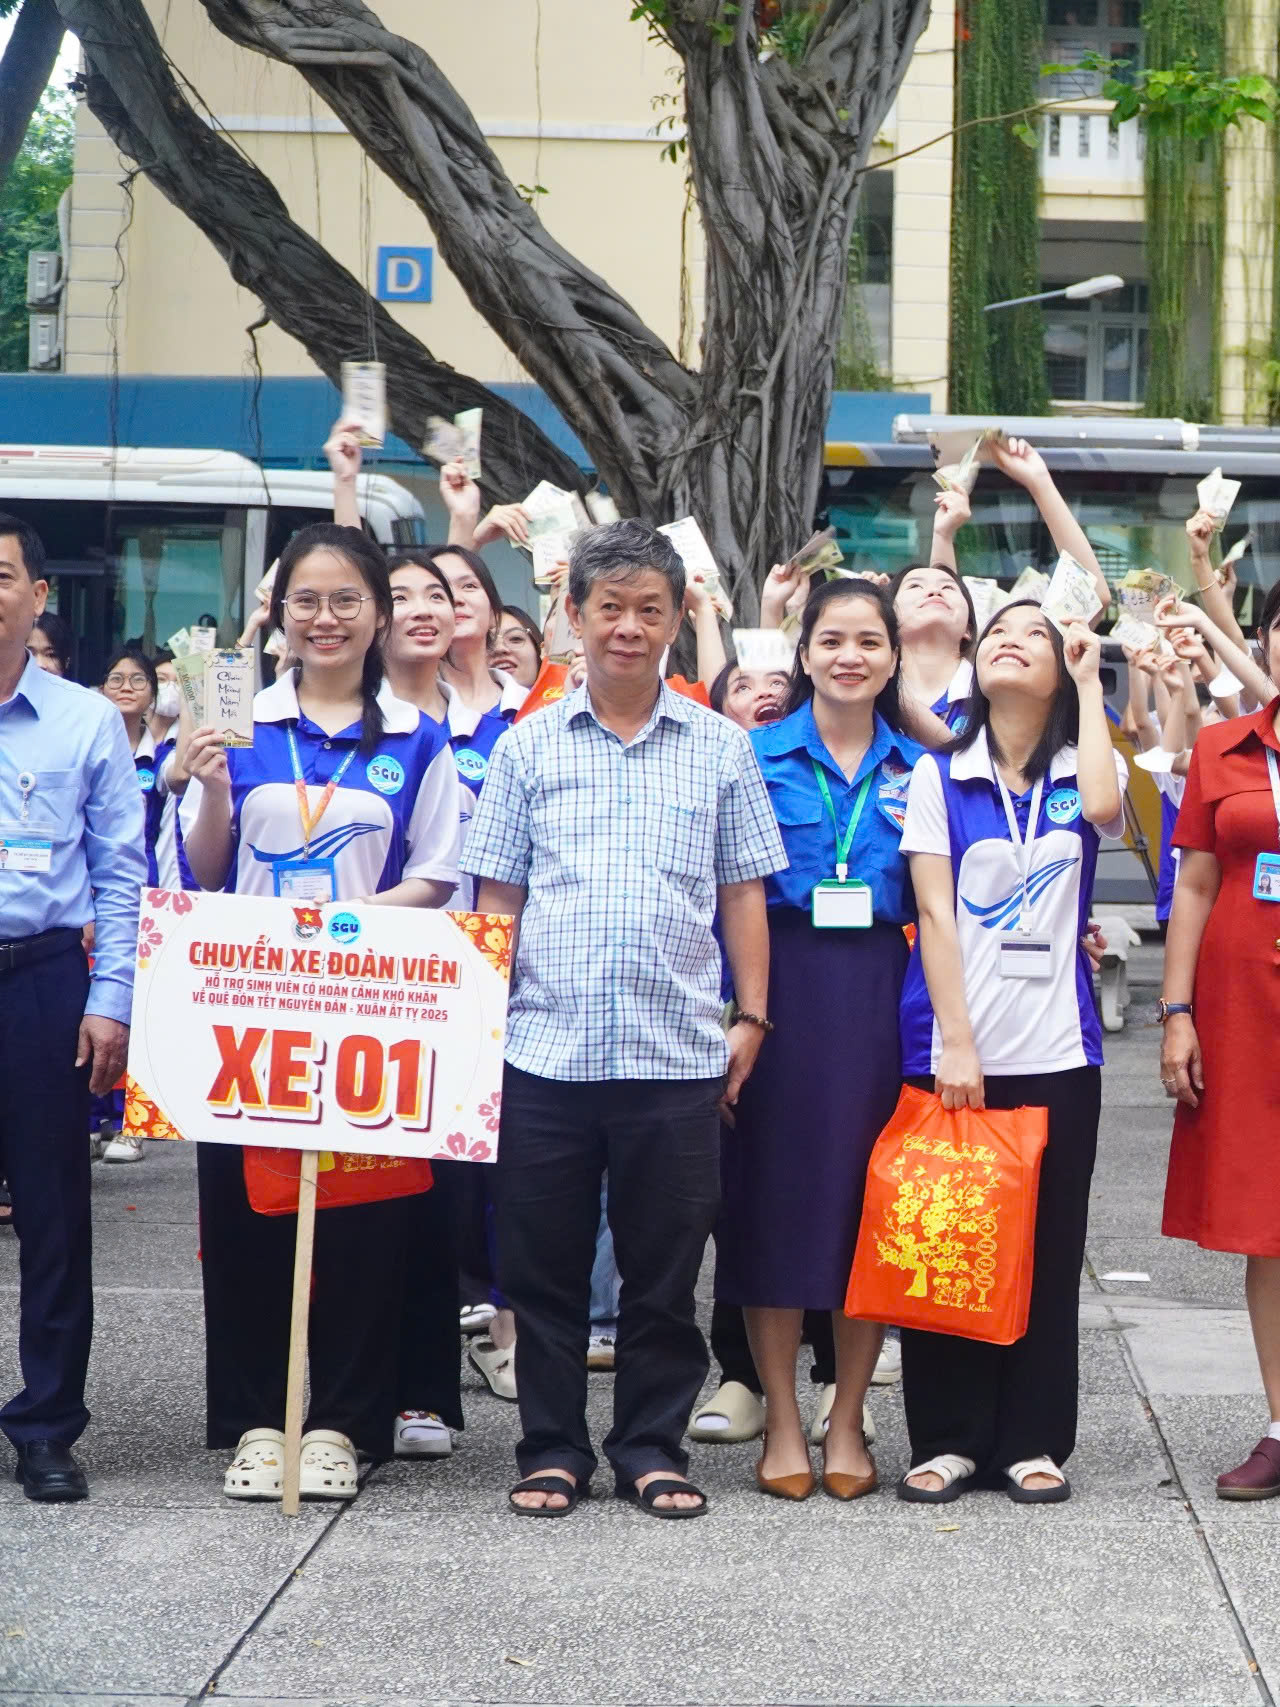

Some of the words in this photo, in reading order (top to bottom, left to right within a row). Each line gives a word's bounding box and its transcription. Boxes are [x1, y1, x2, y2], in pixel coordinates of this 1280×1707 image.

[387, 256, 422, 293] D
[371, 764, 400, 782] SGU
[457, 757, 483, 769] SGU
[1050, 797, 1077, 813] SGU
[331, 922, 359, 933] SGU
[189, 935, 285, 973] CHUYẾN
[290, 949, 322, 975] XE
[327, 948, 396, 981] ĐOÀN
[402, 953, 459, 985] VIÊN
[205, 972, 220, 987] HỖ
[223, 977, 244, 993] TRỢ
[246, 979, 272, 991] SINH
[275, 980, 300, 993] VIÊN
[302, 981, 316, 994] CÓ
[318, 983, 349, 997] HOÀN
[351, 984, 380, 1000] CẢNH
[383, 988, 405, 1001] KHÓ
[407, 990, 438, 1004] KHĂN
[192, 987, 206, 1002] VỀ
[208, 991, 230, 1005] QUÊ
[231, 992, 255, 1006] ĐÓN
[257, 992, 277, 1008] TẾT
[279, 998, 322, 1012] NGUYÊN
[324, 999, 347, 1013] ĐÁN
[356, 1002, 387, 1016] XUÂN
[389, 1001, 403, 1018] ẤT
[405, 1007, 419, 1022] TỴ
[421, 1008, 449, 1021] 2025
[206, 1025, 316, 1112] XE
[335, 1034, 423, 1117] 01
